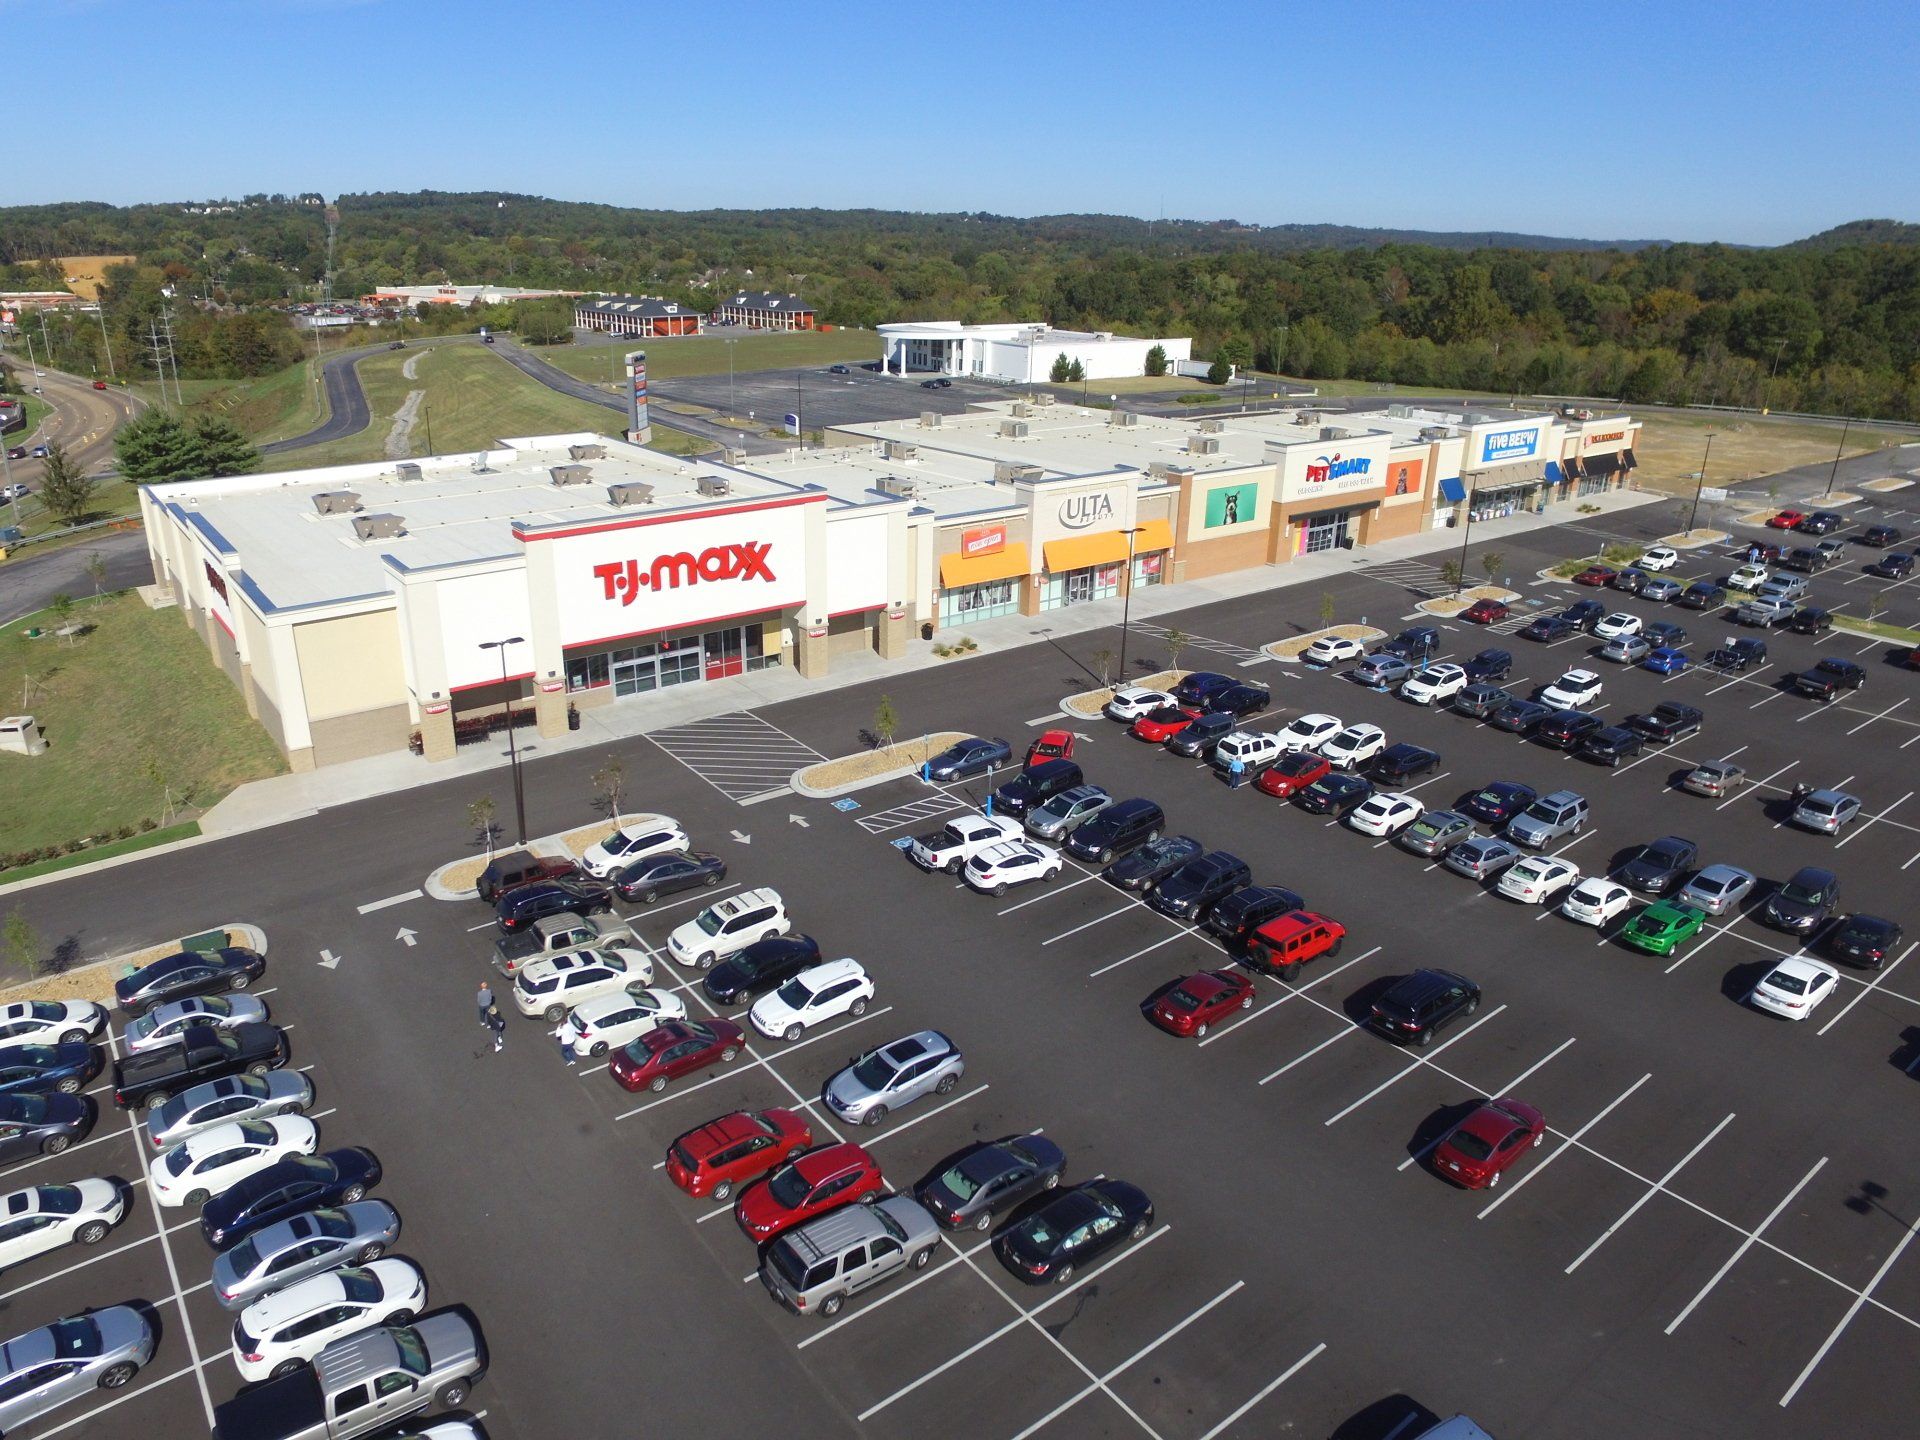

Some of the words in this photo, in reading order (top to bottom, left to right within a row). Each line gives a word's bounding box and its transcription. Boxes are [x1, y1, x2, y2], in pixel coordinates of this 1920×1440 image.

[1488, 433, 1509, 450] five
[1508, 430, 1537, 447] BELOW
[1306, 457, 1371, 482] PETSMART
[1066, 493, 1112, 520] ULTA
